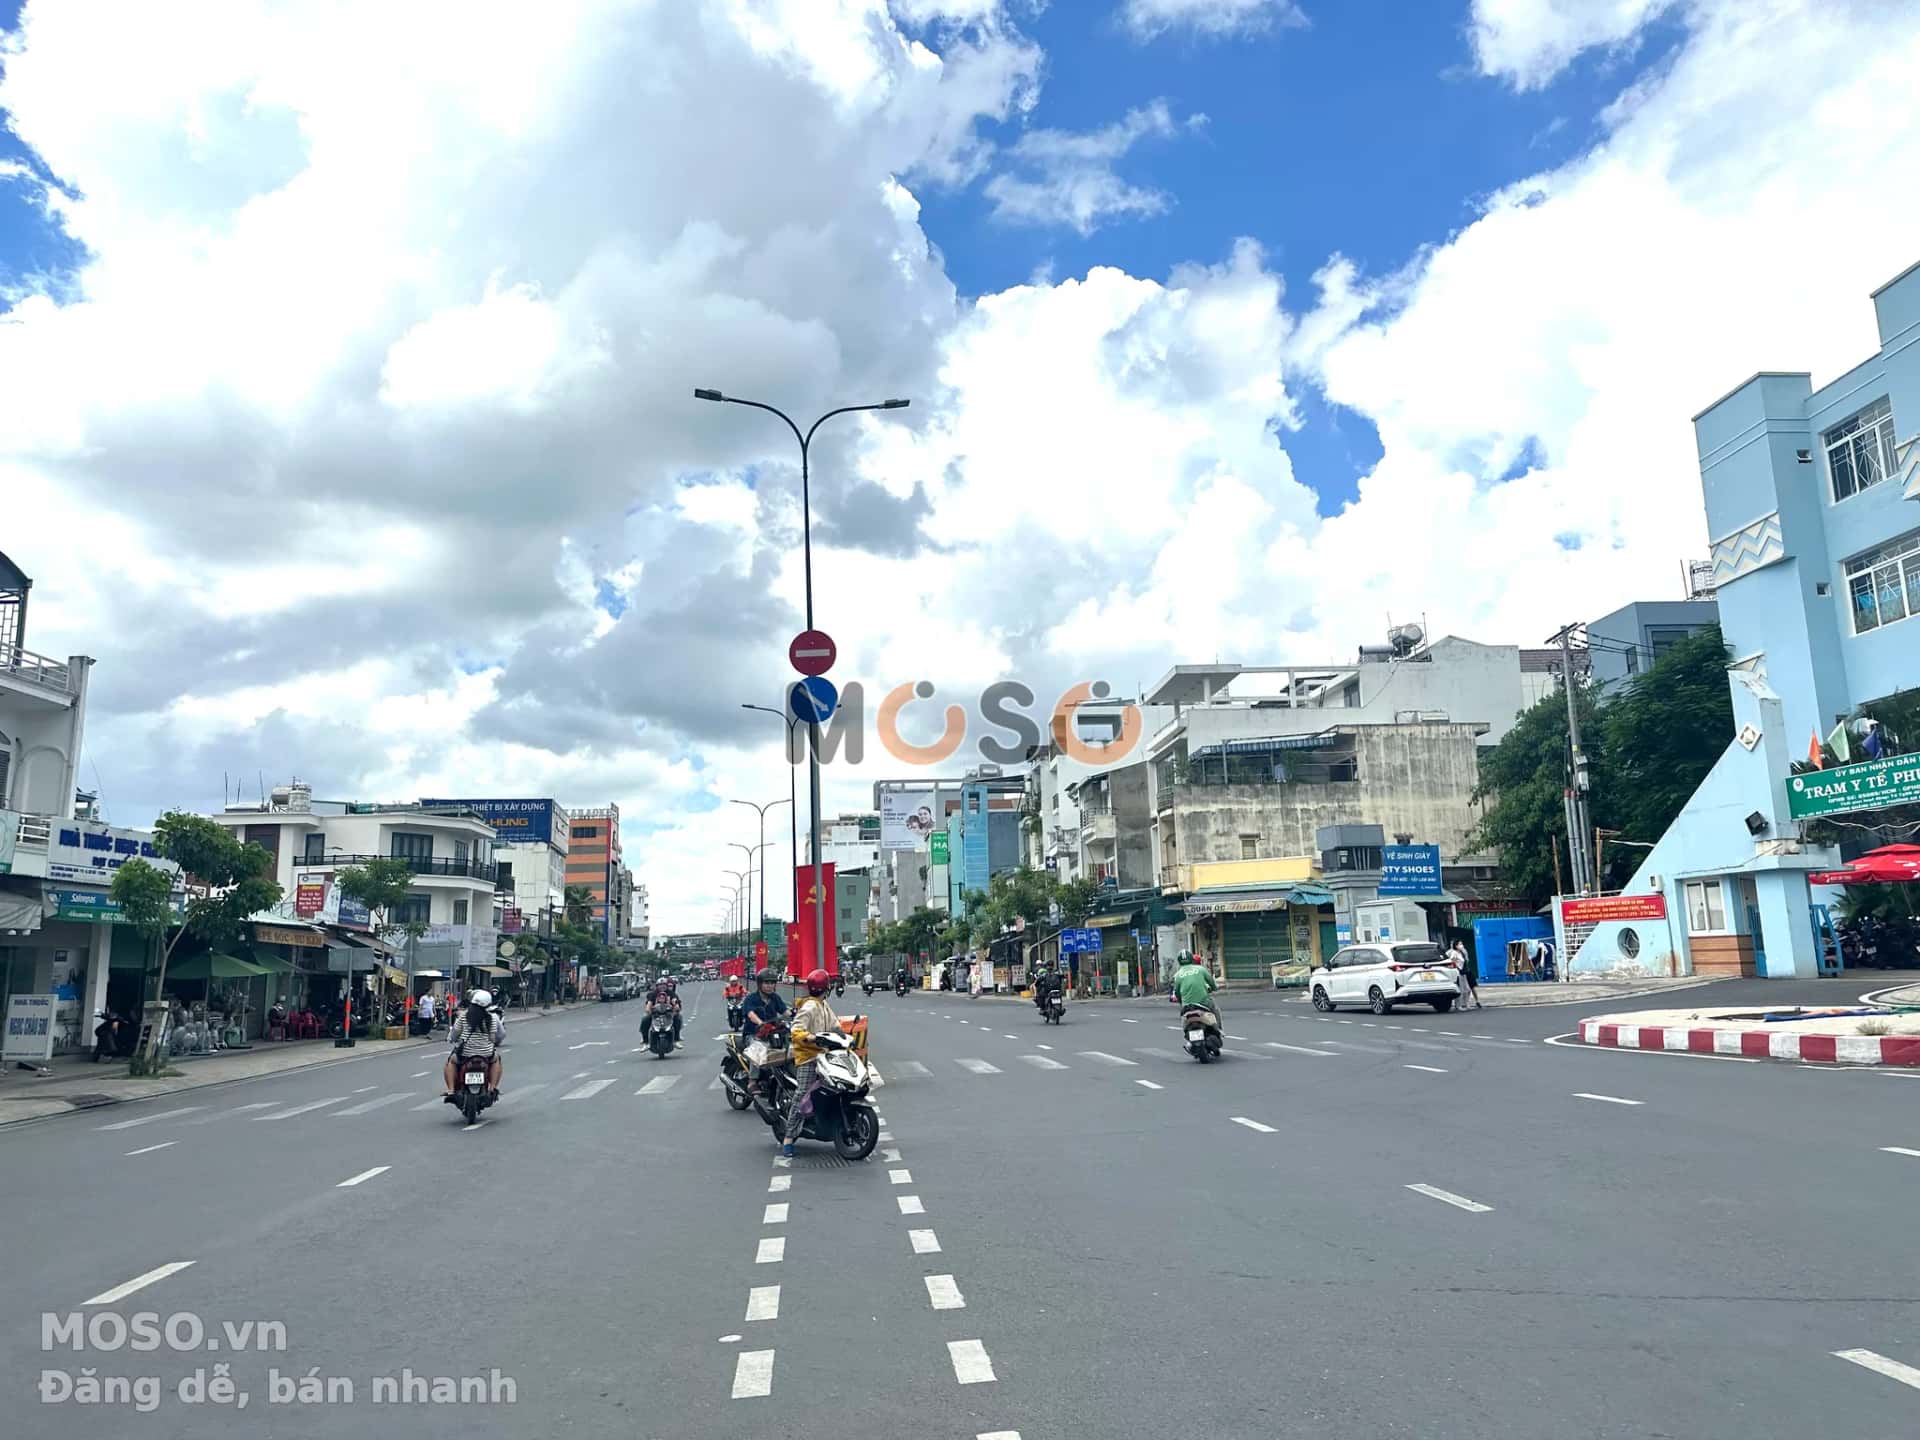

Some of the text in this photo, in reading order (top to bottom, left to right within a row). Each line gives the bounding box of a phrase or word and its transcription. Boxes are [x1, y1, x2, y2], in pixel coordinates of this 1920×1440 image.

[1849, 766, 1867, 775] BAN
[1869, 761, 1895, 772] NHÂN
[1804, 782, 1847, 799] TRẠM
[1850, 779, 1861, 791] Y
[1866, 769, 1888, 789] TẾ
[471, 802, 492, 811] THIẾT
[504, 802, 519, 811] XÂY
[521, 803, 545, 812] DỰNG
[563, 808, 612, 817] ARAOKE
[83, 829, 113, 852] THUỐC
[1396, 852, 1413, 860] SINH
[1381, 865, 1435, 873] RTY SHOES
